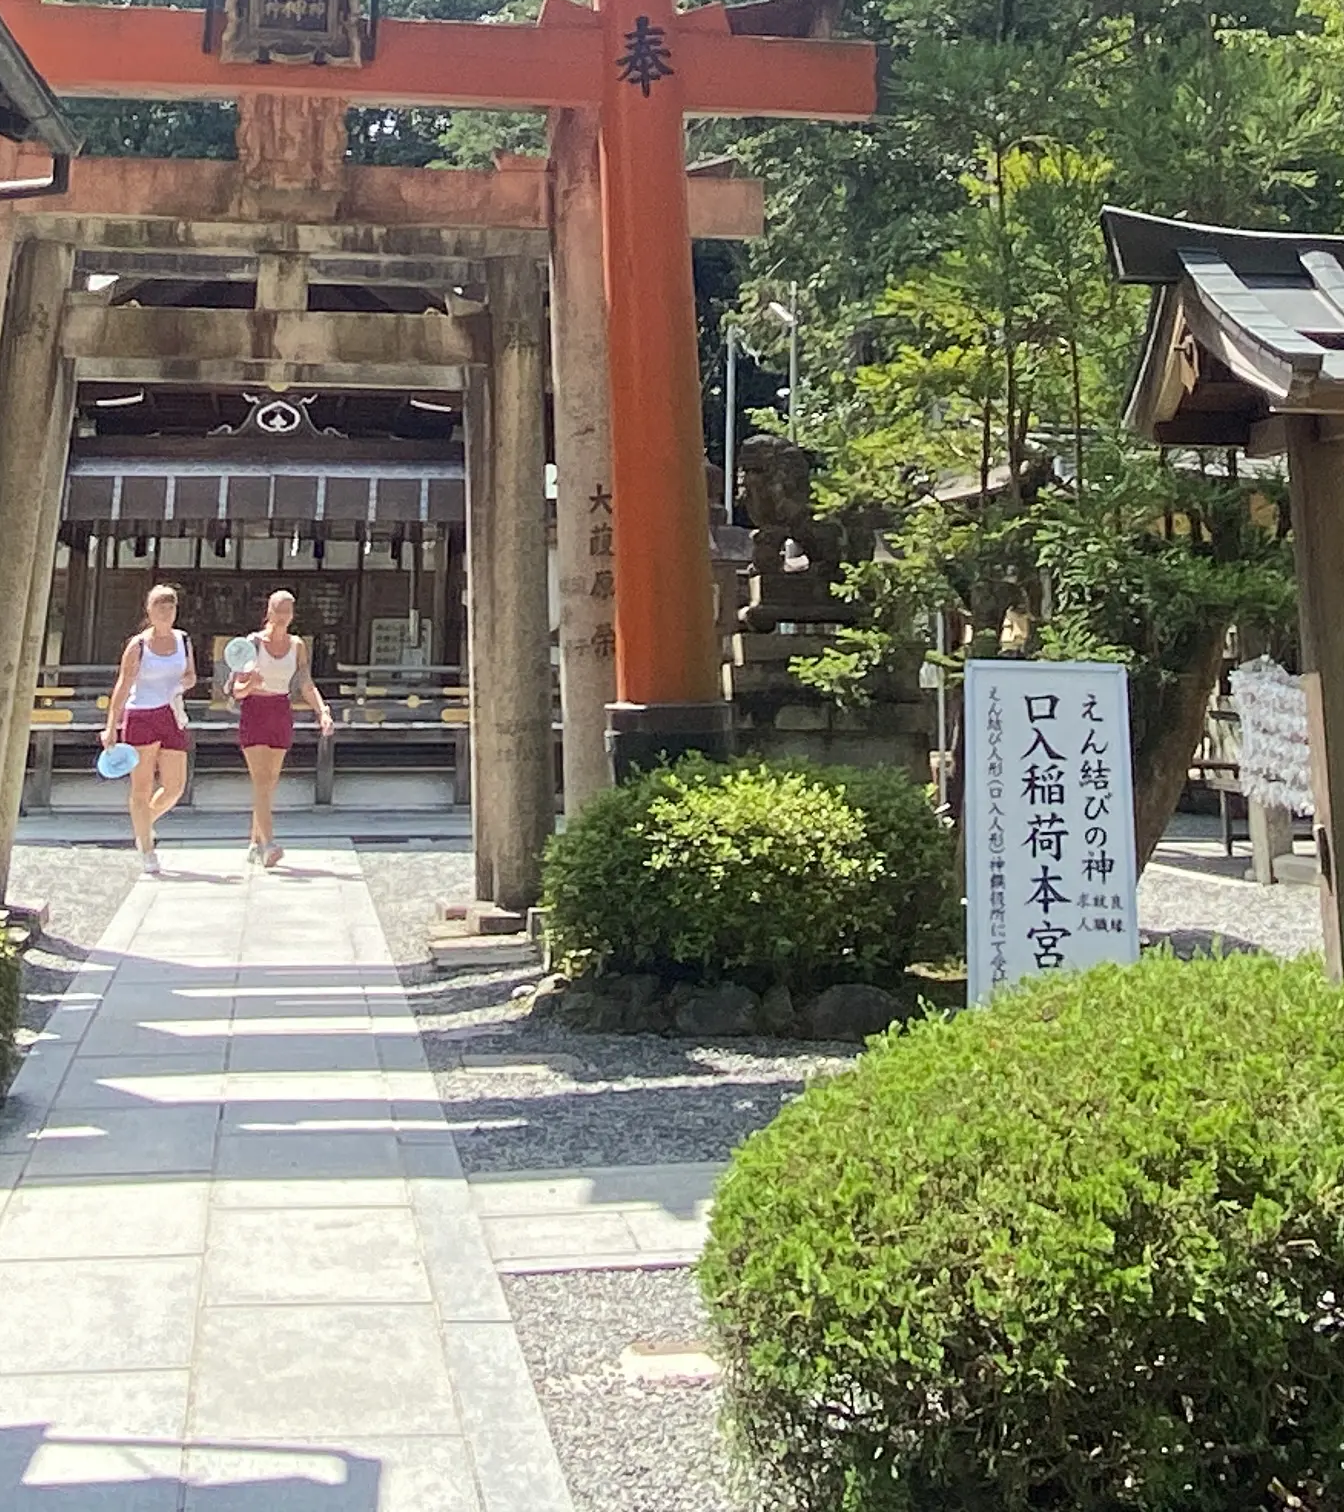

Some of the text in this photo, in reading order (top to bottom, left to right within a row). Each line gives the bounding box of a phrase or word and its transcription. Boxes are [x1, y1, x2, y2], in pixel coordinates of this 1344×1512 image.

[615, 16, 675, 99] 奉
[1019, 693, 1072, 970] 口入稲荷本宮
[1078, 692, 1115, 886] えん結びの神
